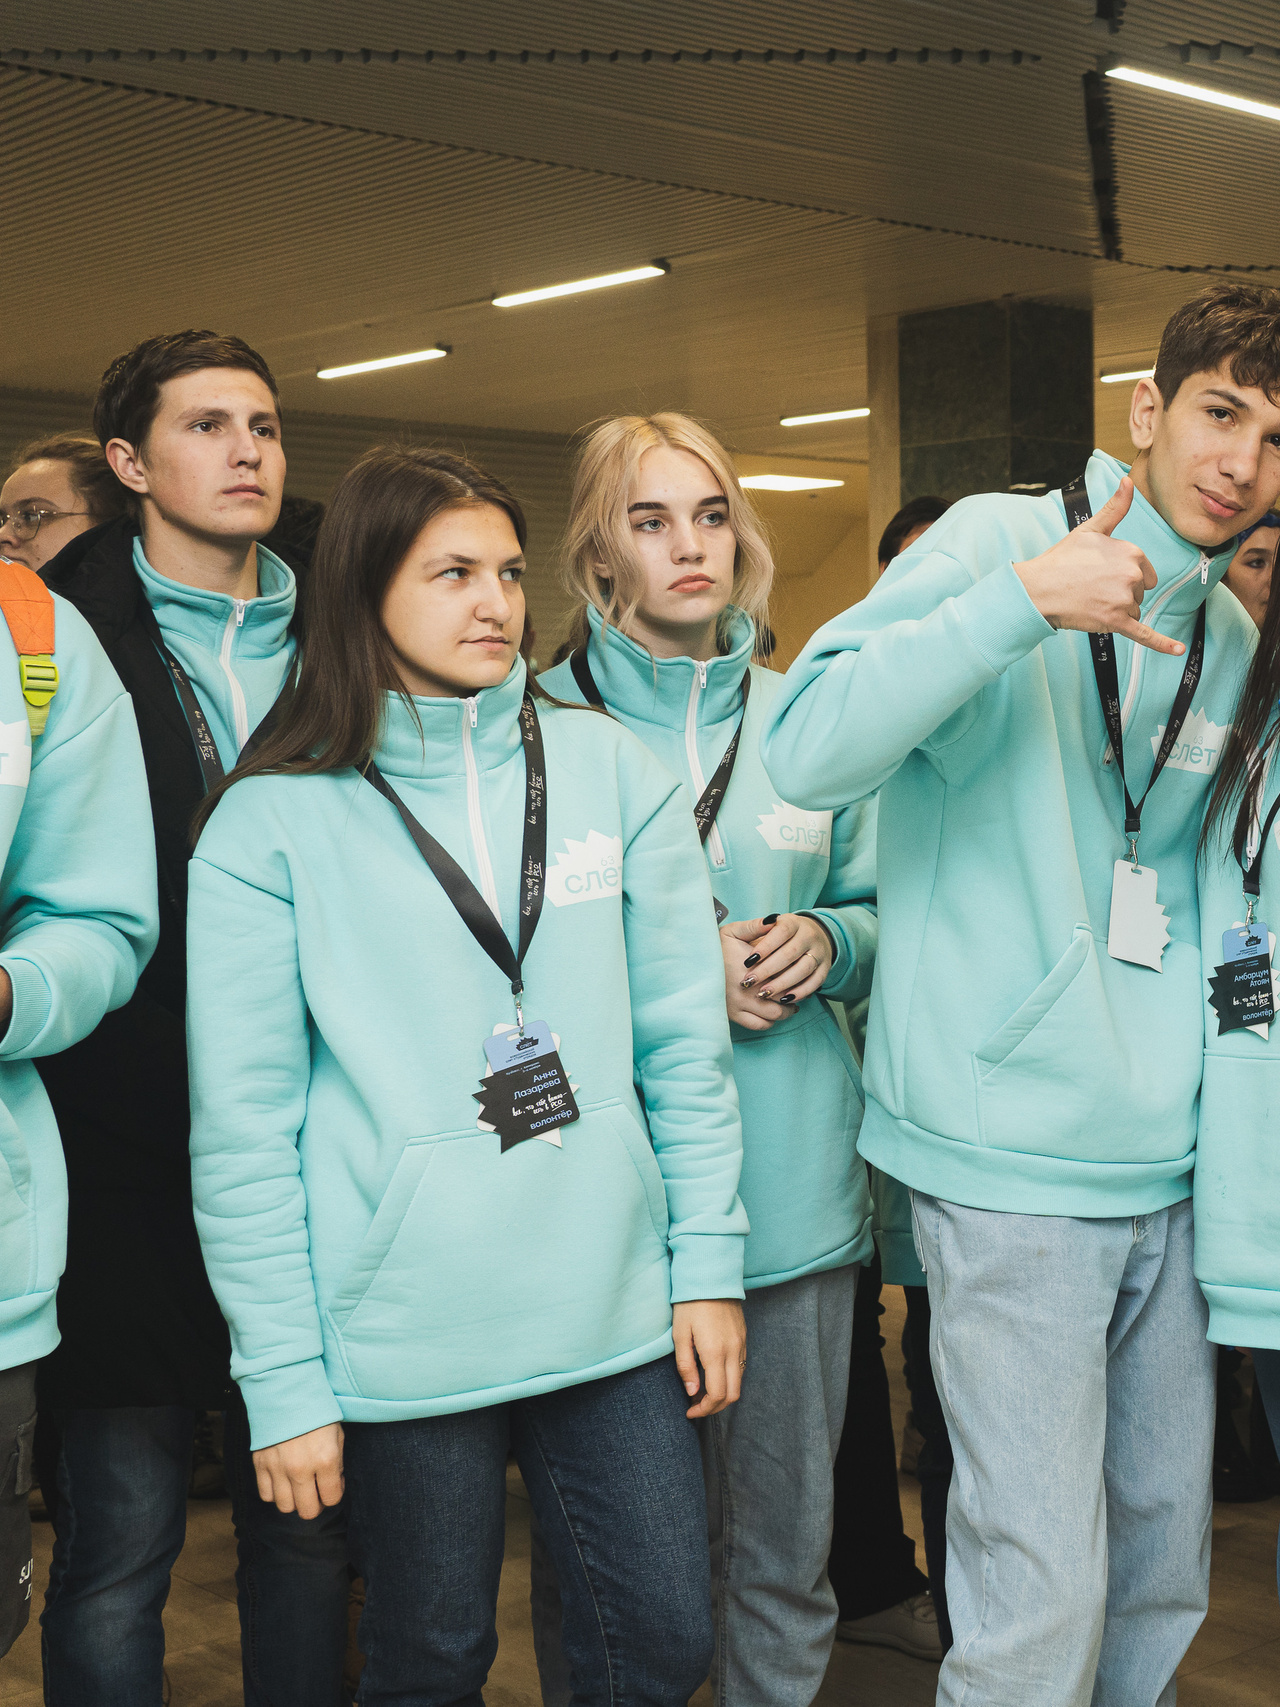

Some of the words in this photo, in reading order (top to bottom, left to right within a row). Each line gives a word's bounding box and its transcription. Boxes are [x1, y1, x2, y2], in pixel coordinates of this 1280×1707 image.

[1194, 736, 1203, 745] 63
[1169, 741, 1217, 766] слет
[780, 825, 827, 850] слет
[601, 855, 615, 867] 63
[1242, 1008, 1273, 1021] волонтёр
[533, 1068, 558, 1083] Анна
[513, 1077, 561, 1100] Лазарева
[530, 1109, 573, 1130] волонтёр
